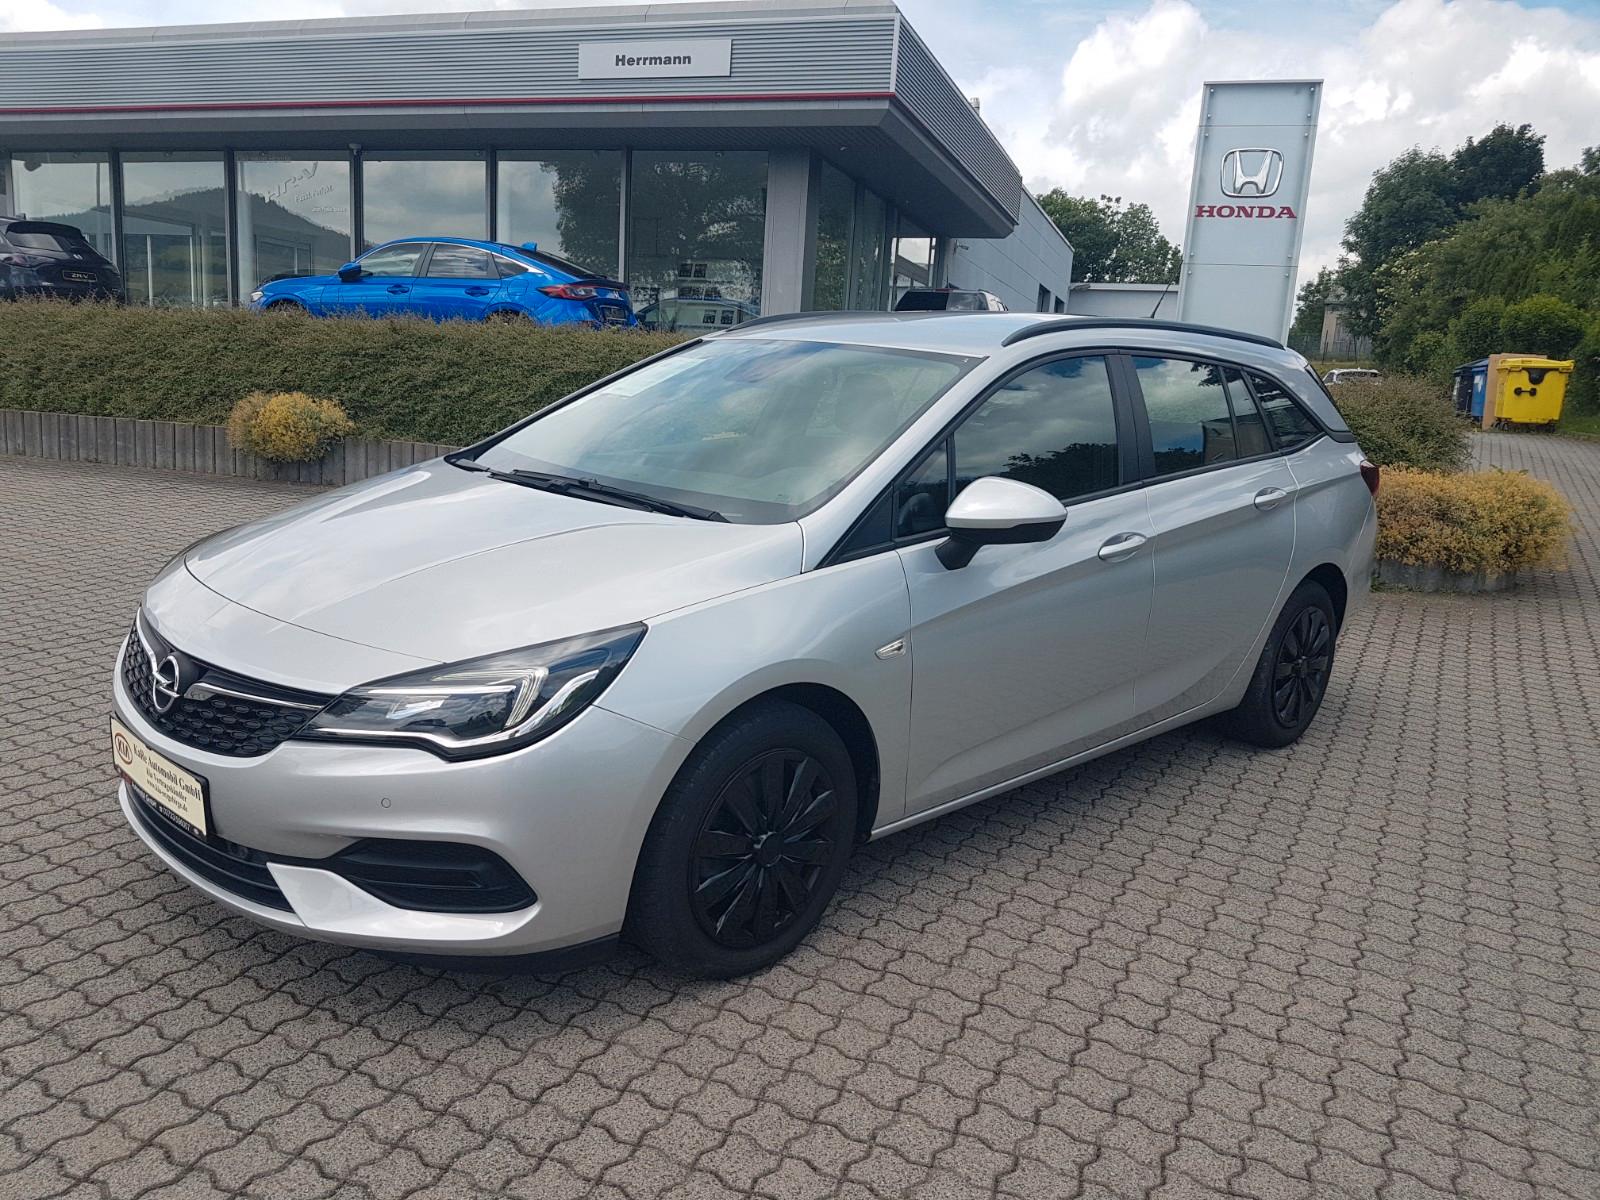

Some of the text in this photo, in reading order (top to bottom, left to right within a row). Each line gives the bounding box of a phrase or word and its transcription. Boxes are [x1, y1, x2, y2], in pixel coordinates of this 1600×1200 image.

[615, 54, 691, 67] Herrmann
[1195, 205, 1297, 219] HONDA
[117, 738, 129, 758] KIA
[147, 755, 178, 786] Automobil
[178, 777, 201, 801] GmbH
